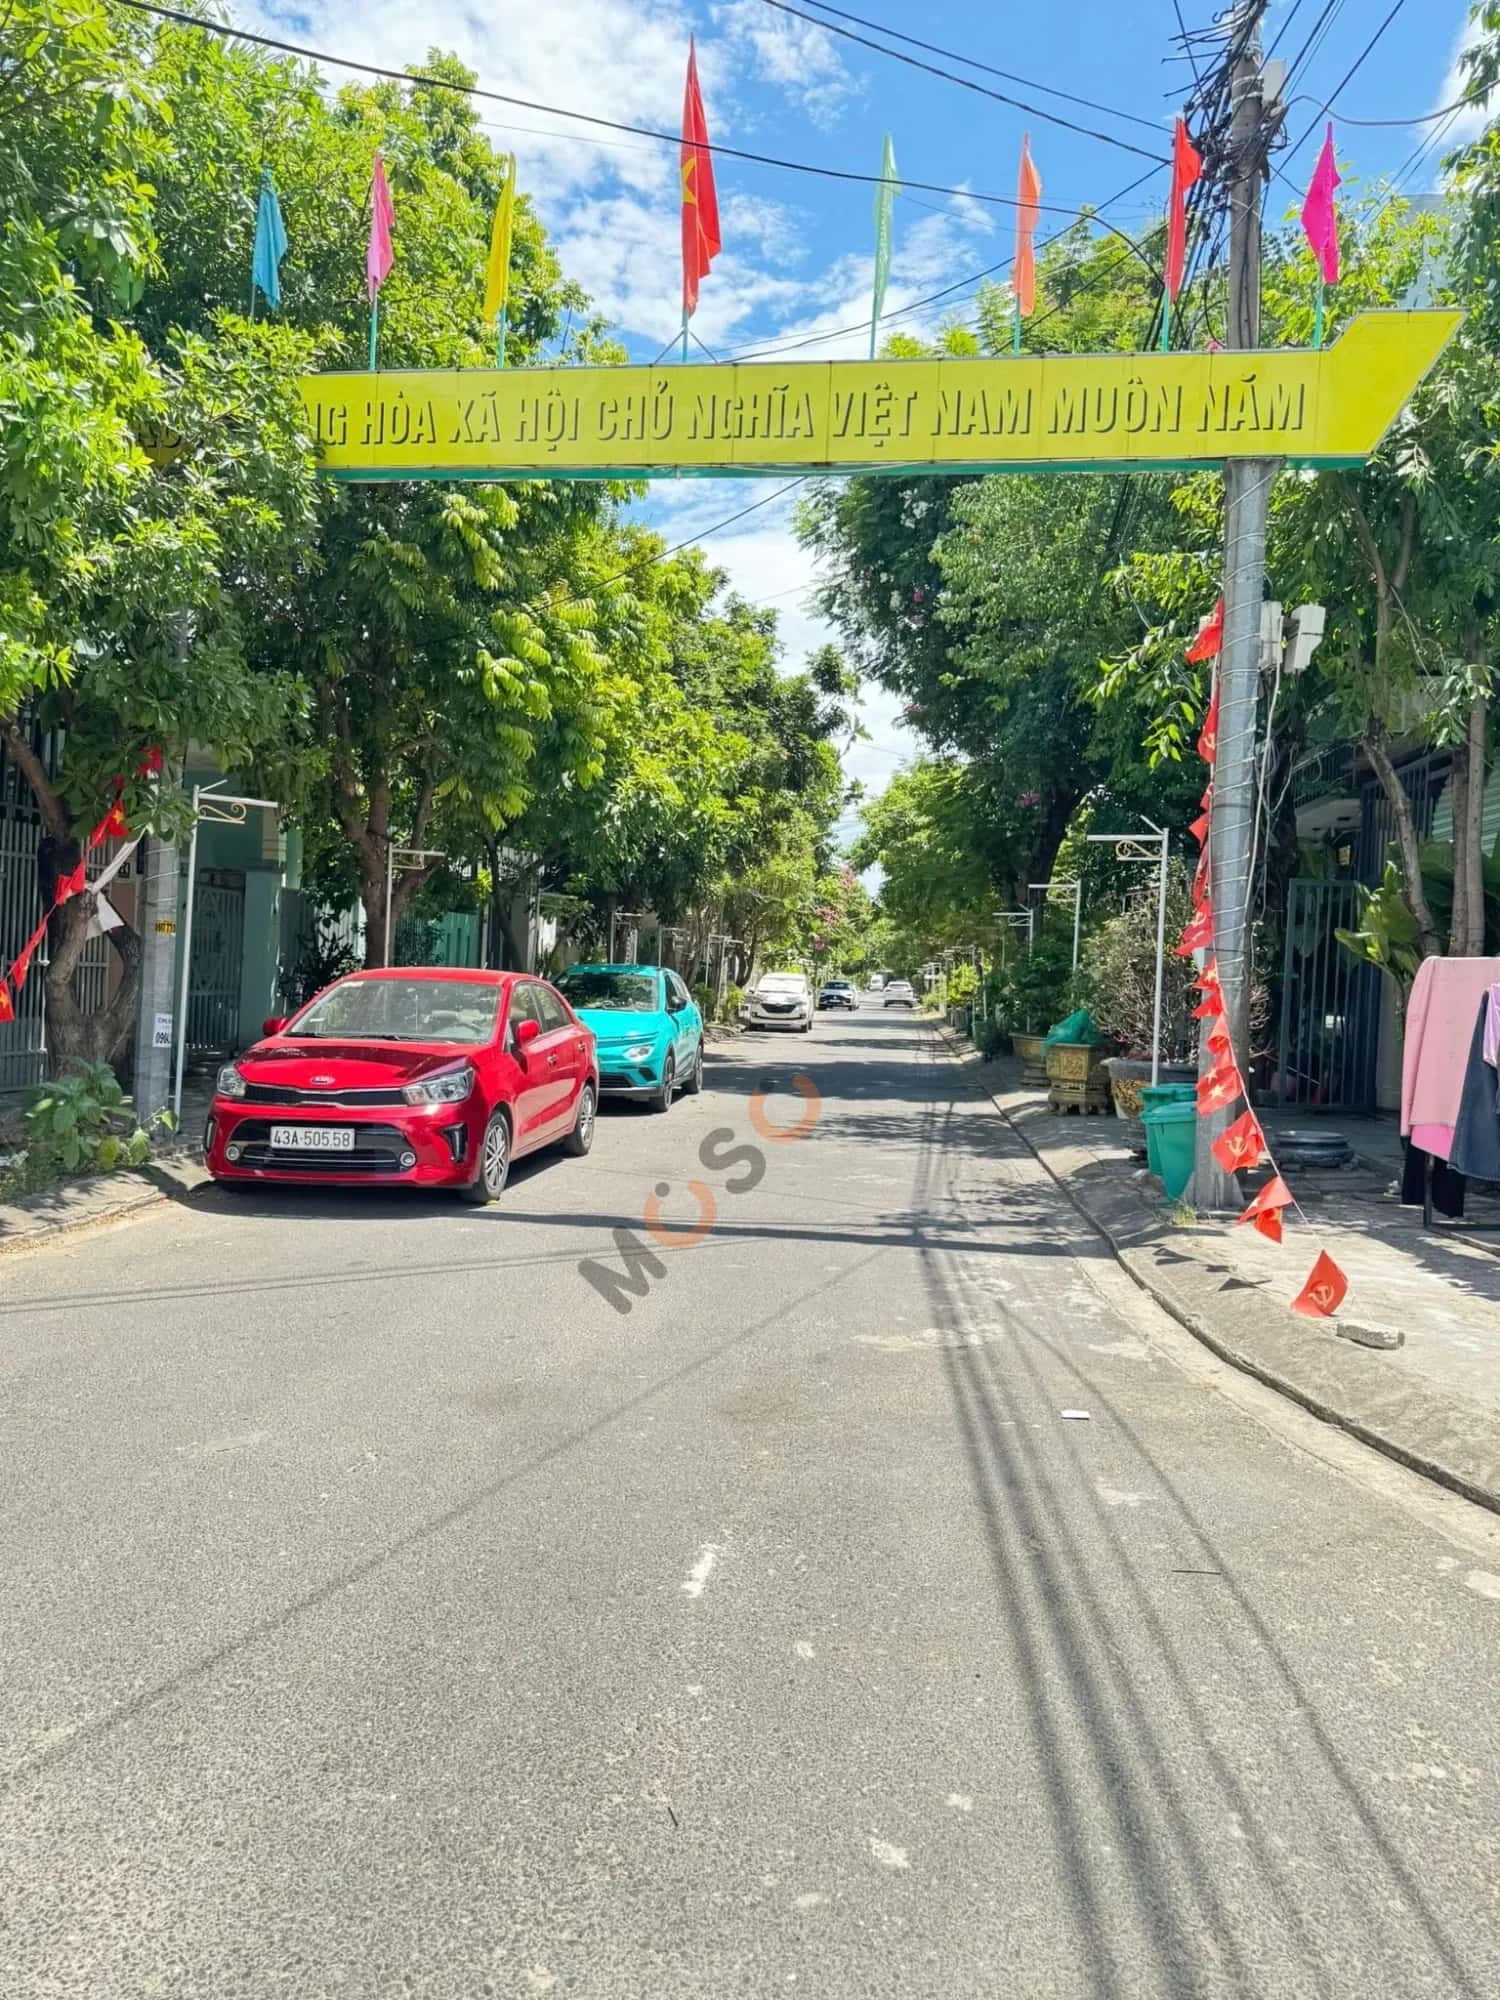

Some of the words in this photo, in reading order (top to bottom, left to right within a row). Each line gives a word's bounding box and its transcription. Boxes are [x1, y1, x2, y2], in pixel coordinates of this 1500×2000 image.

[303, 402, 347, 446] NG
[360, 391, 437, 445] HÒA
[447, 390, 501, 443] XÃ
[513, 390, 579, 452] HỘI
[596, 380, 674, 441] CHỦ
[687, 384, 815, 440] NGHĨA
[831, 381, 919, 448] VIỆT
[930, 388, 1033, 436] NAM
[1047, 376, 1184, 434] MUÔN
[1196, 373, 1306, 432] NĂM
